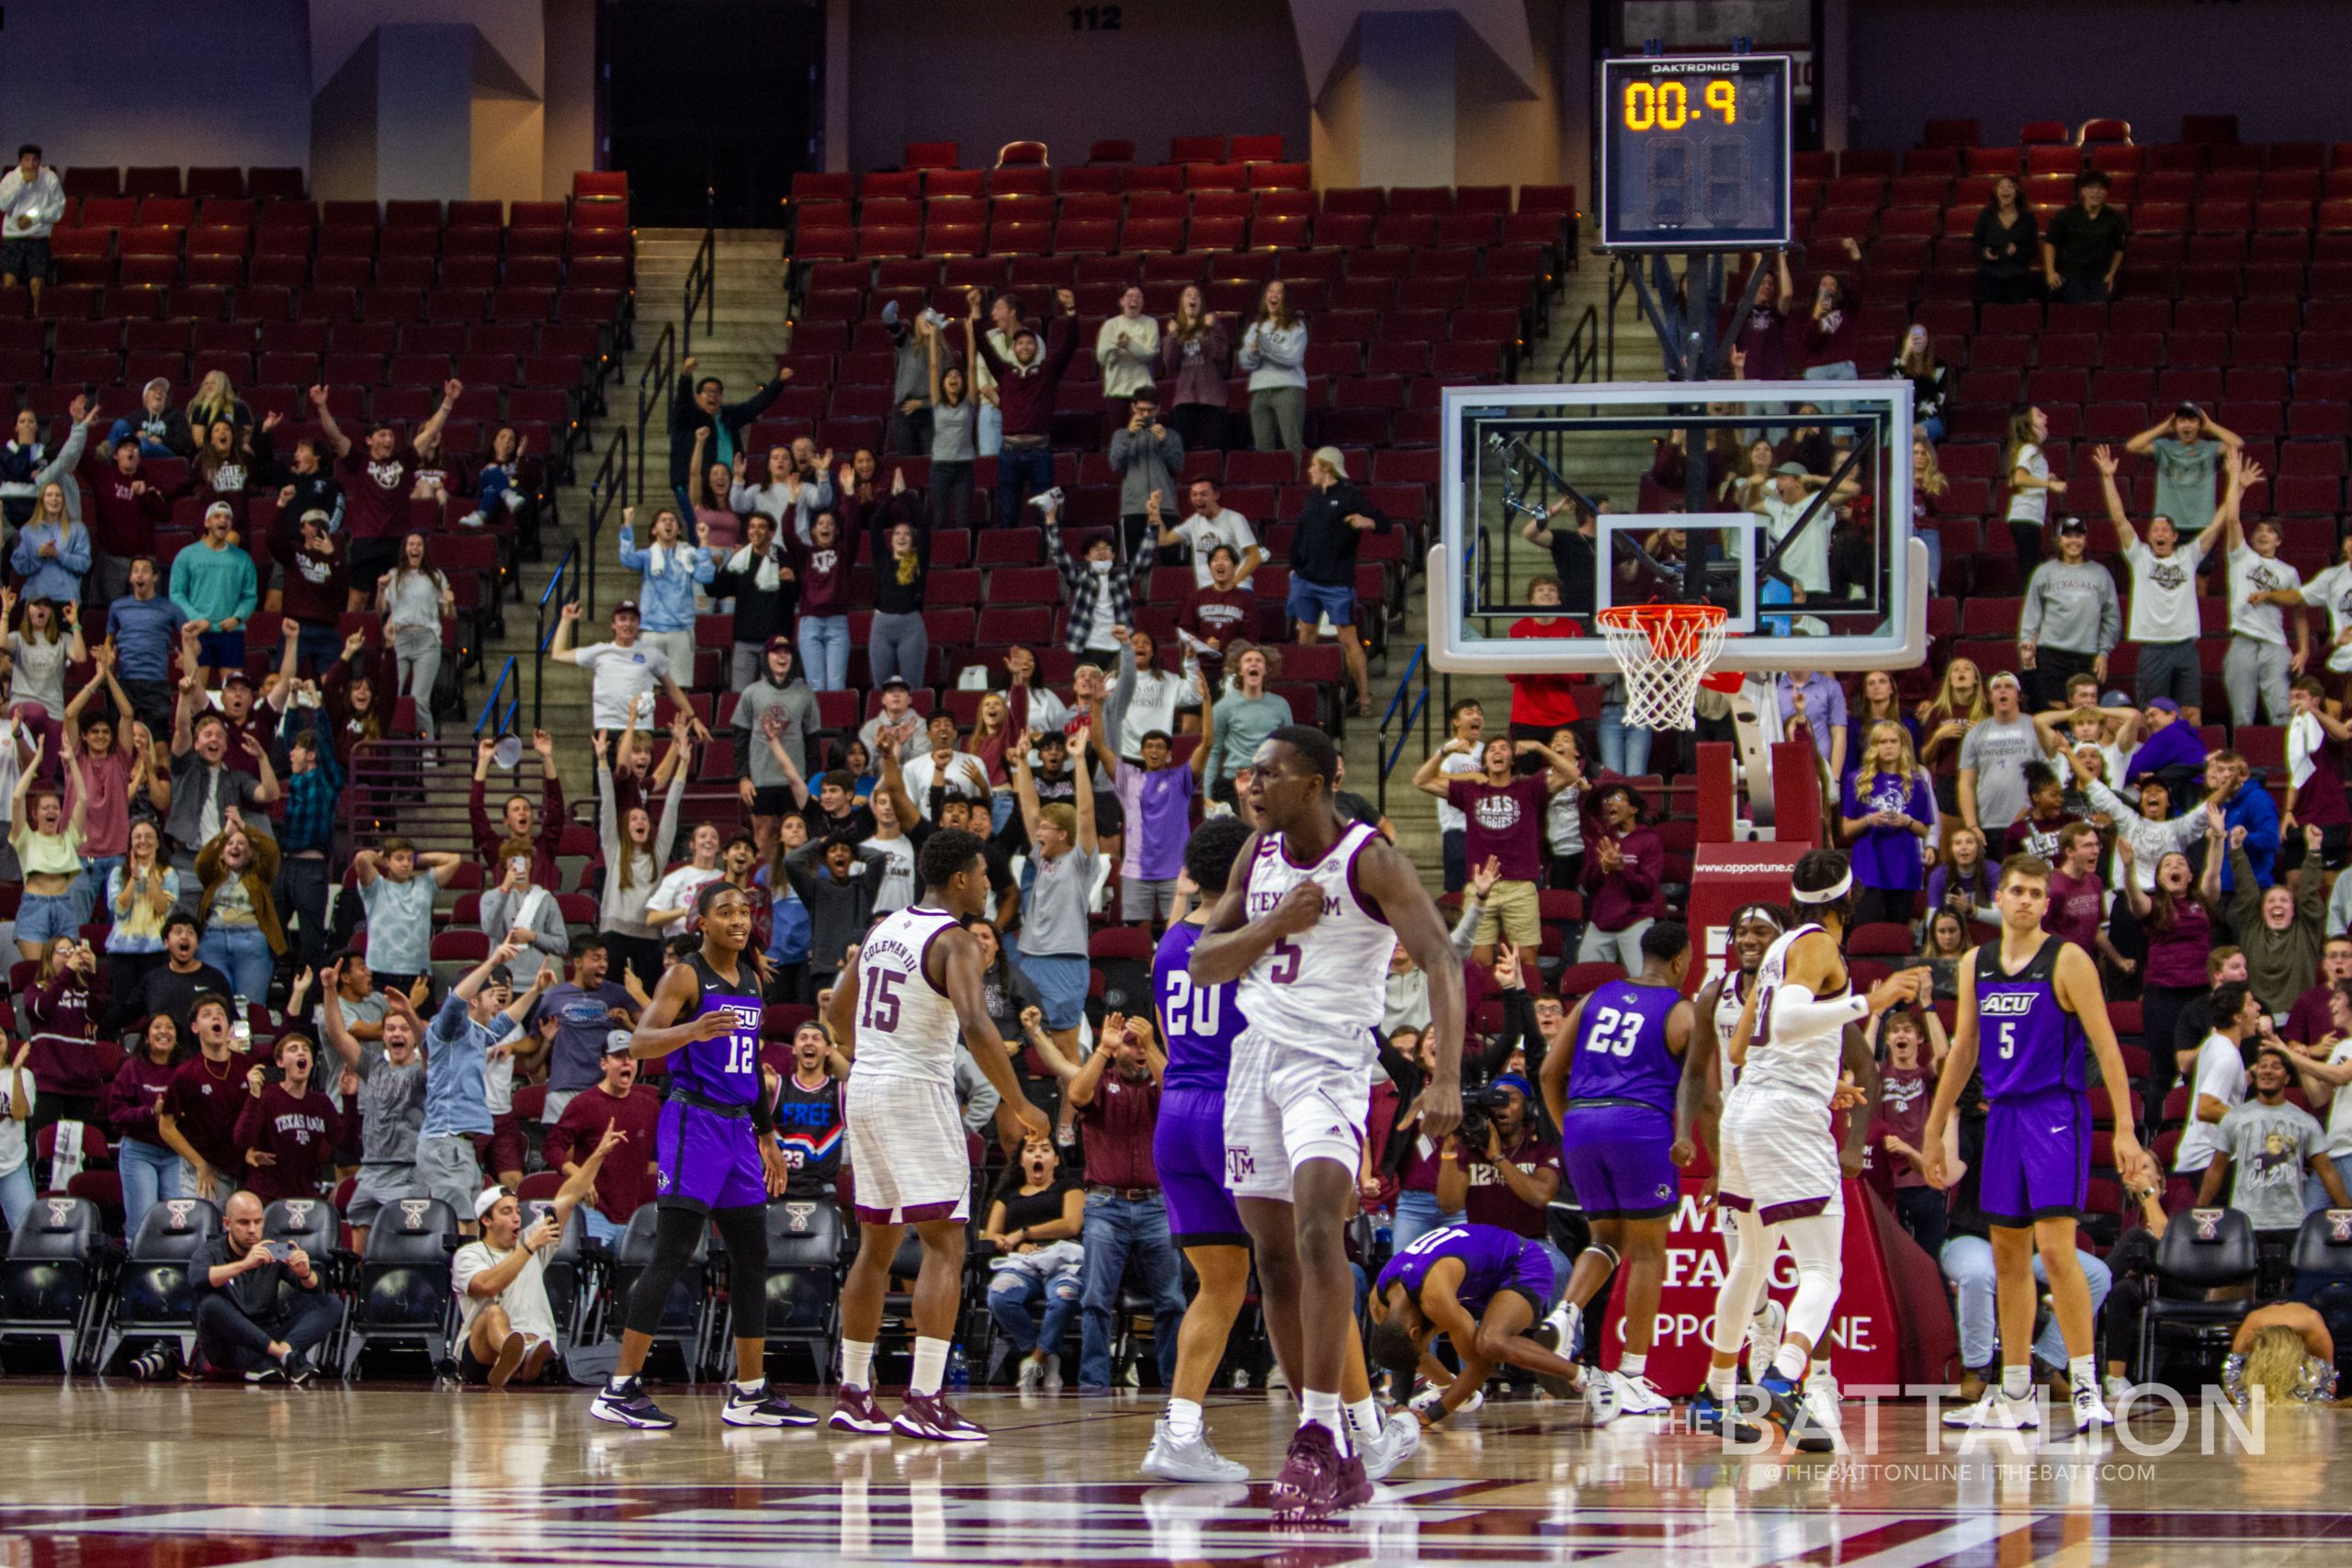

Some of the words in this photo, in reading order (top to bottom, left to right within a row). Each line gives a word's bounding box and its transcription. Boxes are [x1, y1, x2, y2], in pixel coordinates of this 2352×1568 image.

[1069, 6, 1123, 29] 112
[1651, 62, 1740, 73] DAKTRONICS
[1624, 79, 1736, 130] 00.9
[1980, 748, 2029, 757] UNIVERSITY
[864, 940, 908, 963] COLEMAN
[903, 954, 917, 974] III
[1271, 936, 1303, 985] 5
[862, 965, 908, 1033] 15
[1166, 969, 1221, 1037] 20
[1980, 992, 2041, 1016] ACU
[1586, 1006, 1645, 1057] 23
[1999, 1021, 2016, 1059] 5
[724, 1035, 753, 1074] 12
[275, 1113, 305, 1133] TEXAS
[783, 1102, 832, 1127] FREE
